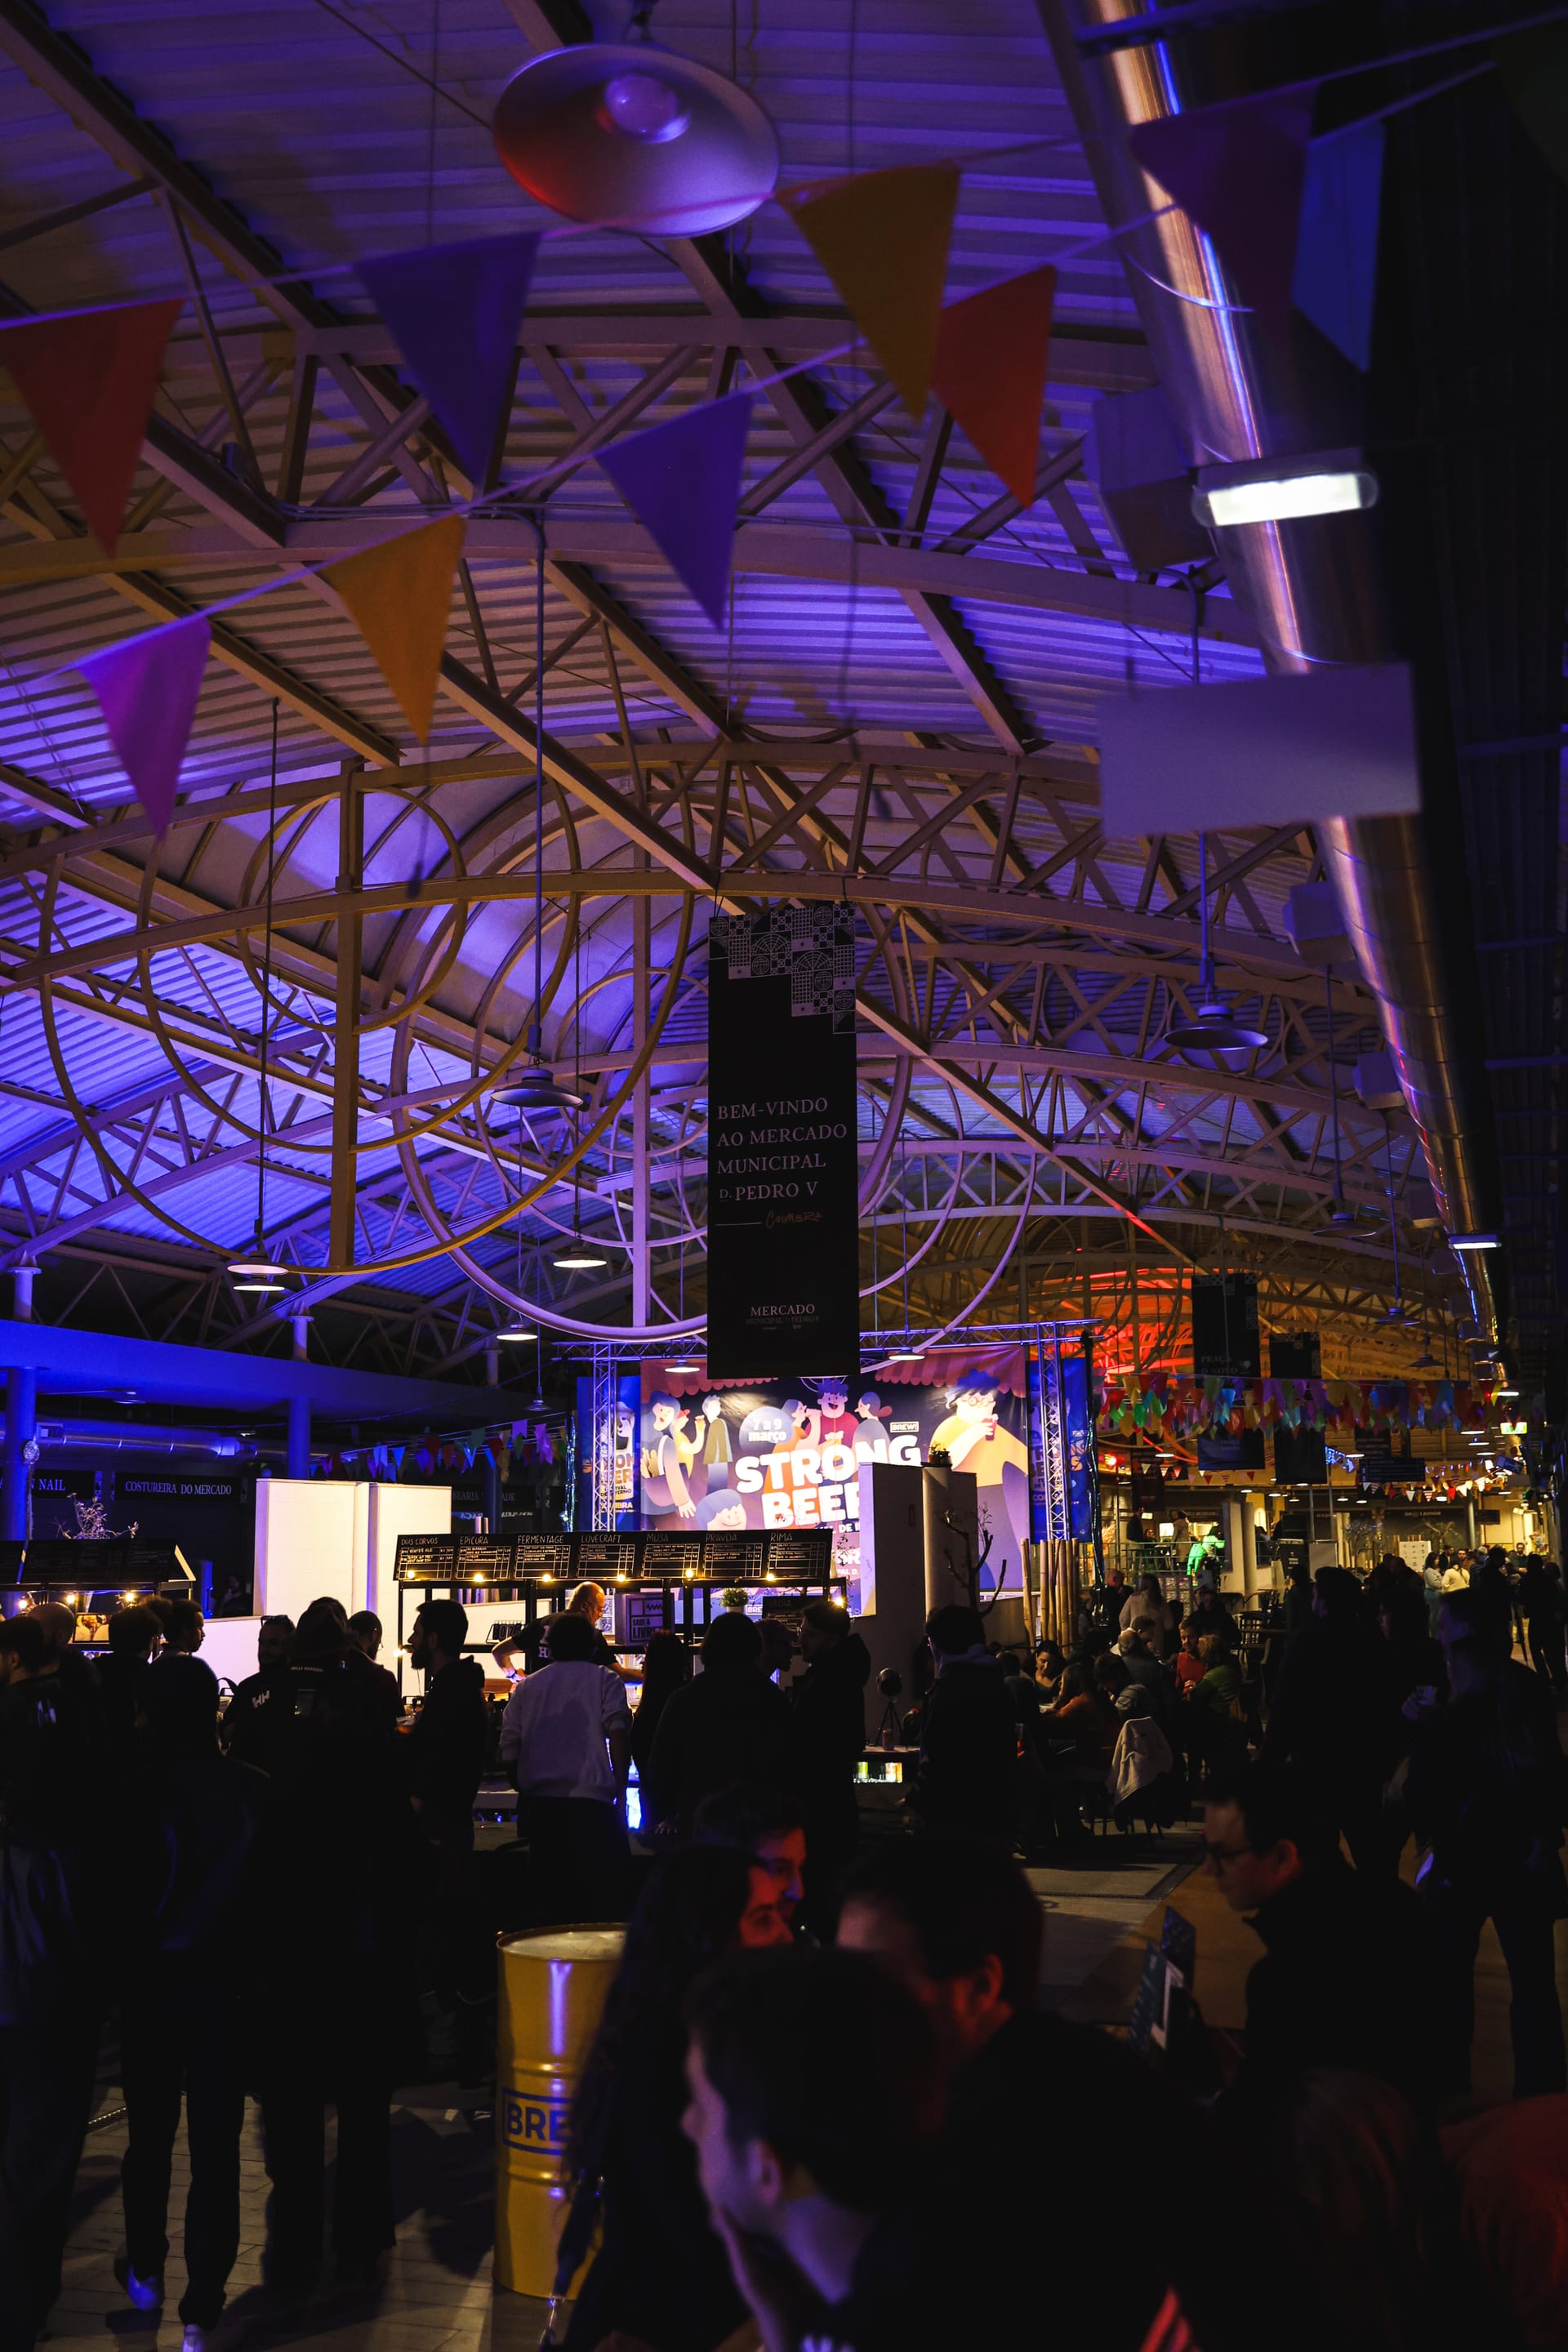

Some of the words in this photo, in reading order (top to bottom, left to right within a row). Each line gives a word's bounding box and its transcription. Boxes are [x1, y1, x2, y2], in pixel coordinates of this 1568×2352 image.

[717, 1097, 828, 1120] BEM-VINDO
[716, 1131, 744, 1147] AO
[751, 1124, 848, 1144] MERCADO
[717, 1153, 826, 1174] MUNICIPAL
[719, 1188, 733, 1199] D.
[735, 1183, 800, 1201] PEDRO
[806, 1181, 819, 1196] V
[751, 1303, 815, 1316] MERCADO
[752, 1419, 760, 1431] 7
[763, 1420, 771, 1431] a
[773, 1417, 782, 1430] 9
[748, 1430, 787, 1443] março
[735, 1435, 922, 1494] STRONG
[38, 1478, 66, 1491] NAIL
[125, 1481, 176, 1494] COSTUREIRA
[180, 1483, 193, 1494] DO
[194, 1483, 232, 1496] MERCADO
[415, 1537, 439, 1545] CORVOS
[460, 1535, 488, 1545] EPICURA
[517, 1535, 564, 1544] FERMENTAGE
[581, 1535, 621, 1544] LOVECRAFT
[646, 1534, 669, 1543] MUSA
[706, 1533, 737, 1543] PRAVDA
[770, 1532, 793, 1542] RIMA
[747, 1606, 763, 1614] BRE
[507, 2101, 570, 2143] BRE
